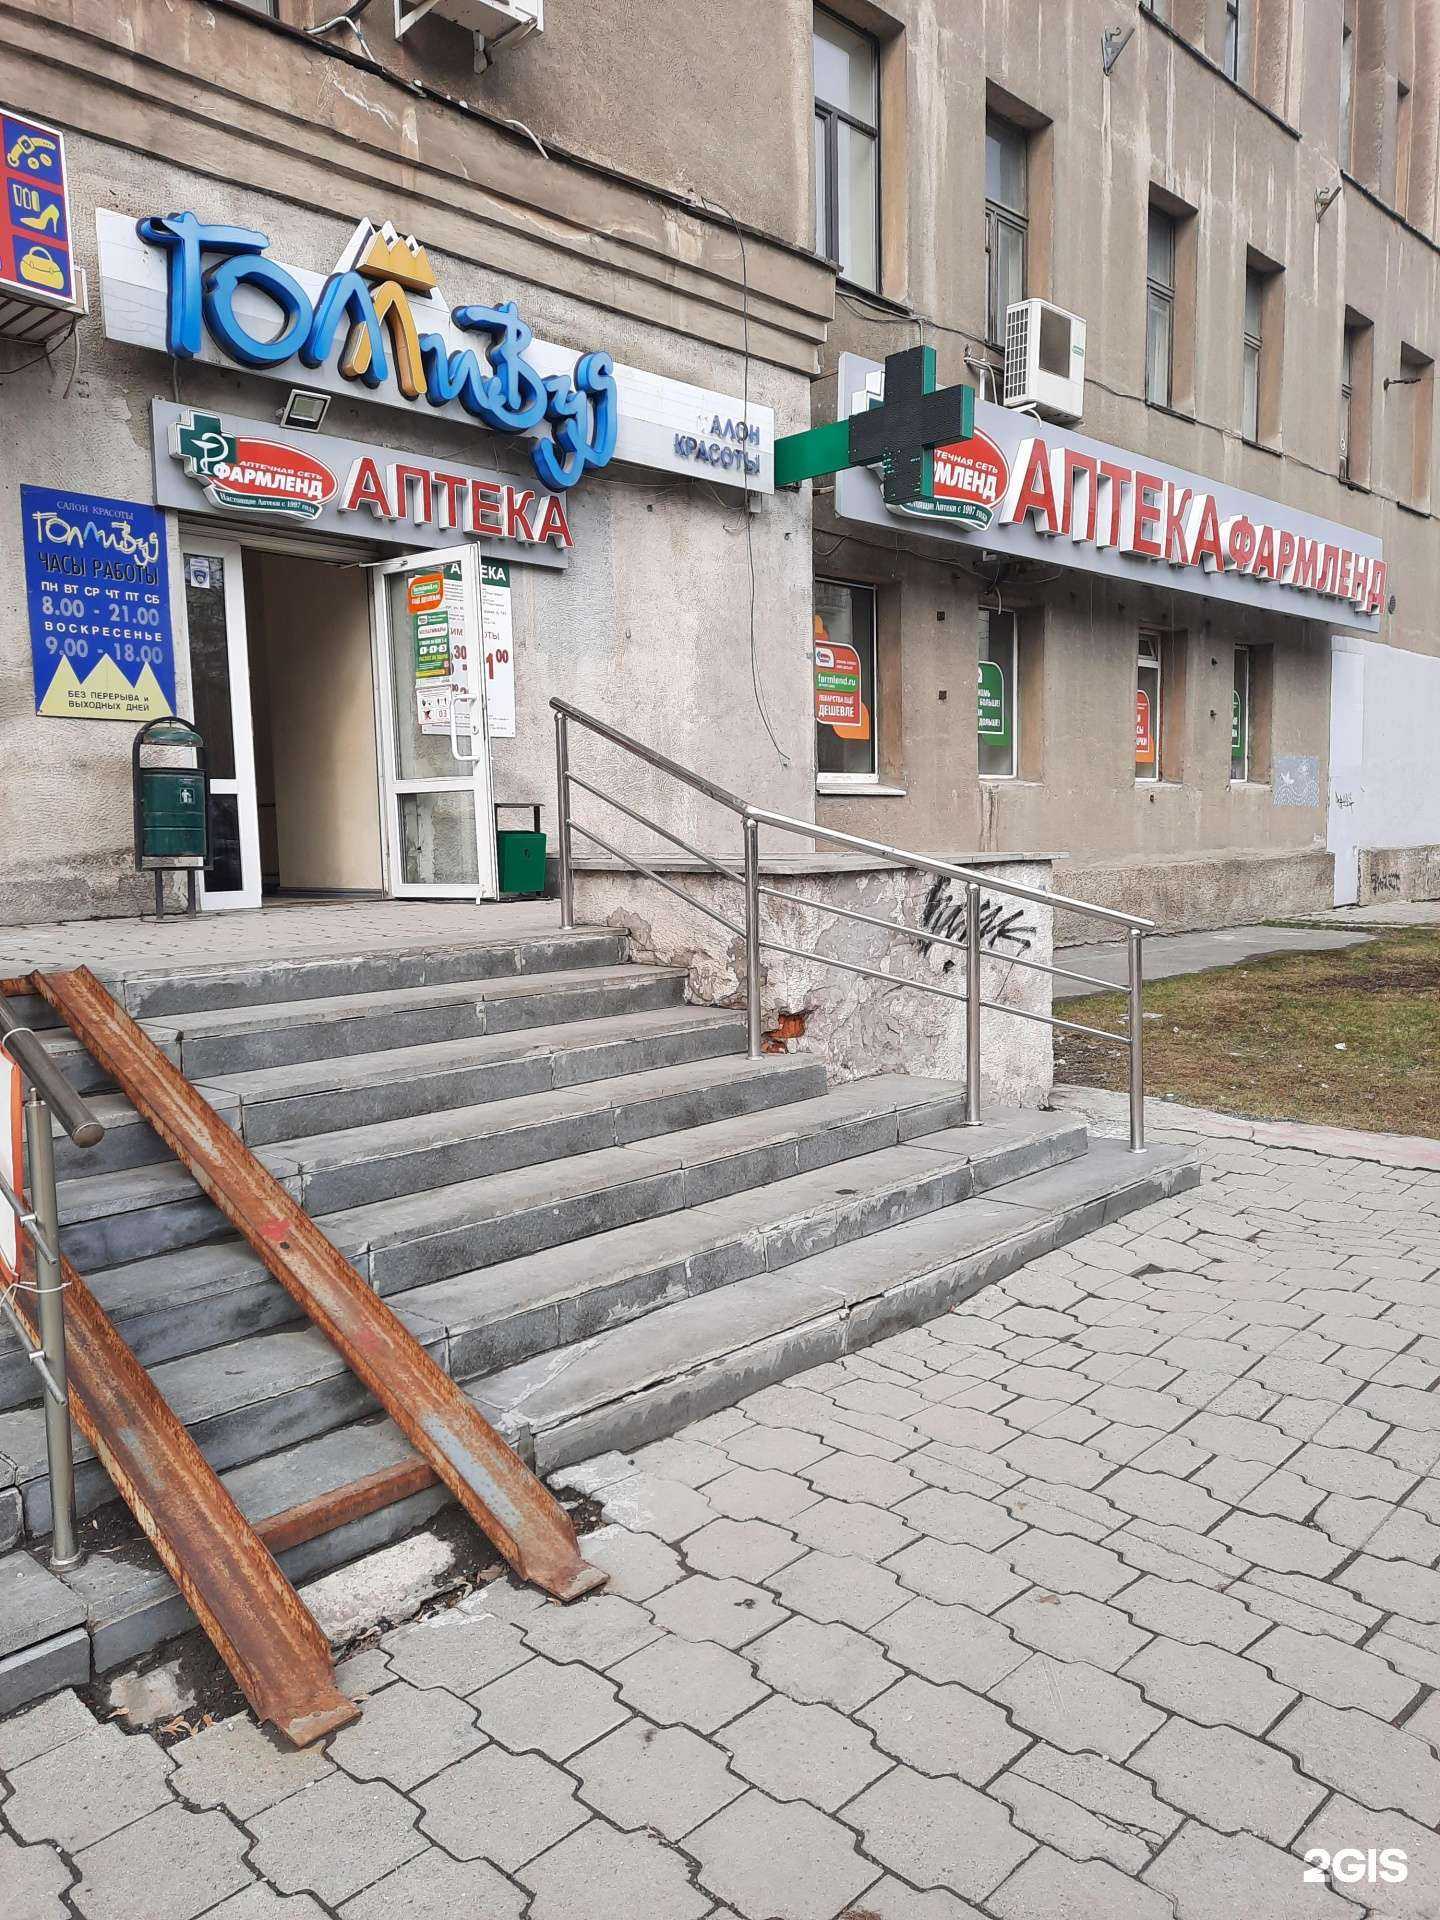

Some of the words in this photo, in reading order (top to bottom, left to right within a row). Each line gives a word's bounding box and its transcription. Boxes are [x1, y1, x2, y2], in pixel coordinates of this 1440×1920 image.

[710, 414, 760, 446] АЛОН
[674, 433, 760, 475] КРАСОТЫ
[934, 449, 973, 467] ТЕЧНАЯ
[975, 461, 998, 474] СЕТЬ
[213, 462, 323, 499] ФАРМЛЕНД
[239, 460, 295, 475] АПТЕЧНАЯ
[297, 470, 323, 480] СЕТЬ
[934, 460, 997, 501] МЛЕНД
[57, 501, 88, 513] САЛОН
[92, 506, 134, 520] КРАСОТЫ
[342, 456, 575, 550] АПТЕКА
[963, 504, 976, 515] 1997
[1003, 437, 1226, 574] АПТЕКА
[1226, 512, 1389, 615] ФАРМЛЕНД
[38, 552, 87, 577] ЧАСЫ
[92, 559, 160, 585] РАБОТЫ
[41, 581, 58, 593] ПН
[64, 583, 79, 595] ВТ
[84, 585, 100, 597] СР
[105, 588, 120, 599] ЧТ
[125, 591, 140, 602] ПТ
[144, 592, 160, 604] СБ
[42, 596, 85, 618] 8.00
[109, 603, 160, 627] 21.00
[44, 621, 163, 642] ВОСКРЕСЕНЬЕ
[45, 636, 88, 658] 9.00
[113, 642, 164, 665] 18.00
[452, 645, 466, 660] 30
[818, 673, 856, 686] farmlend.ru
[68, 690, 87, 699] БЕЗ
[90, 690, 140, 702] ПЕРЕРЫВА
[68, 700, 121, 711] ВЫХОДНЫХ
[126, 702, 150, 712] ДНЕЙ
[818, 704, 855, 718] ДЕШЕВЛЕ
